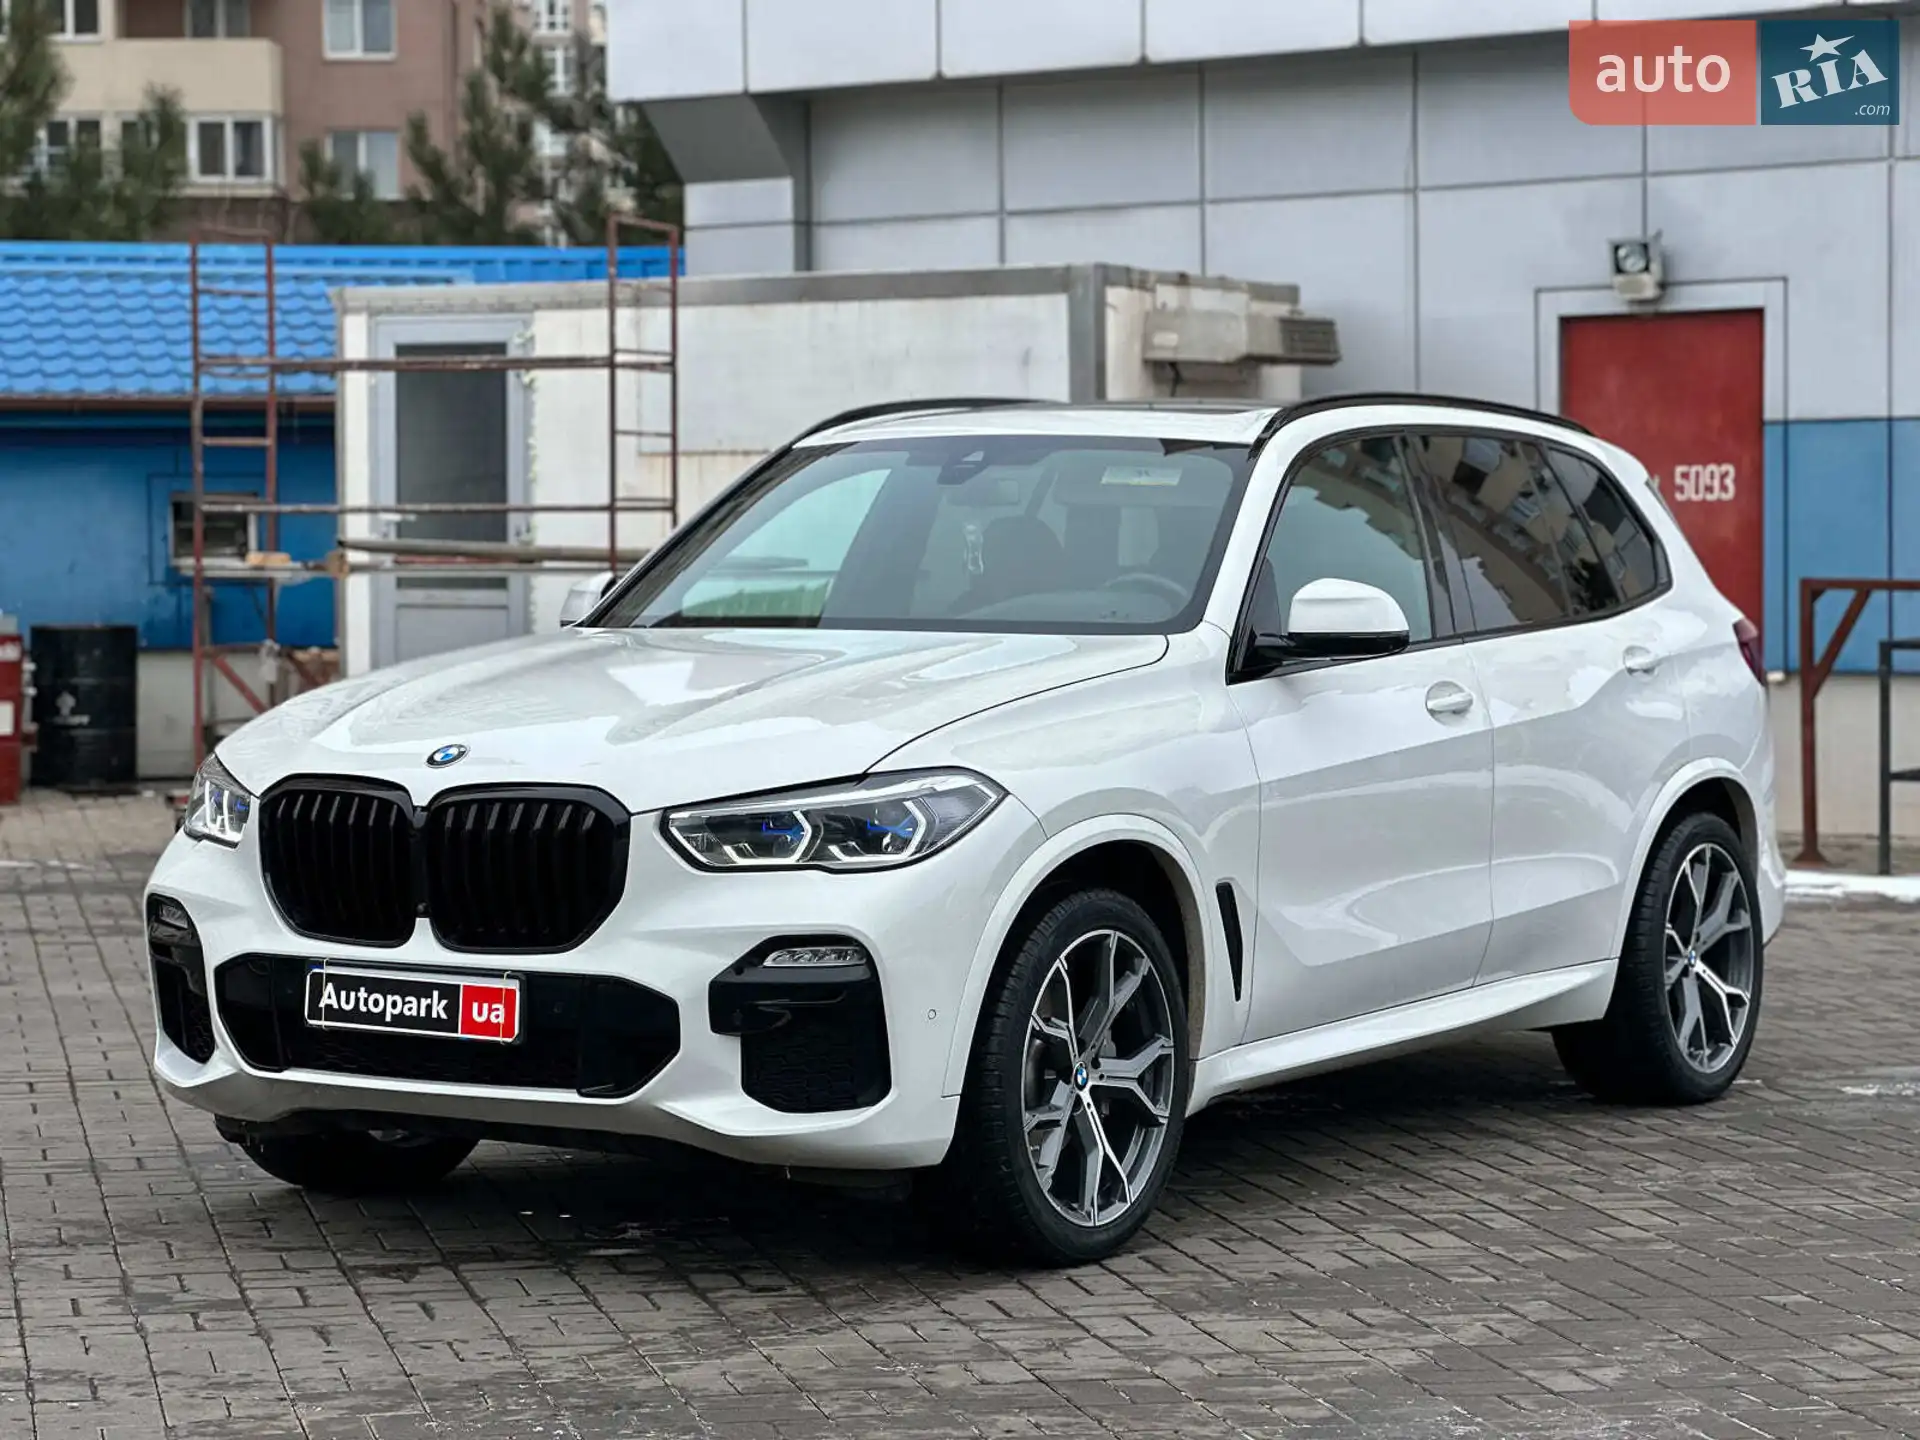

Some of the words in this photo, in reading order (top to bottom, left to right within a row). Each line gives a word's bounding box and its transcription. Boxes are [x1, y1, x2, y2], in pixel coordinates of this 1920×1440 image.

[1674, 463, 1735, 501] 5093
[318, 982, 449, 1022] Autopark
[471, 1001, 506, 1024] ua
